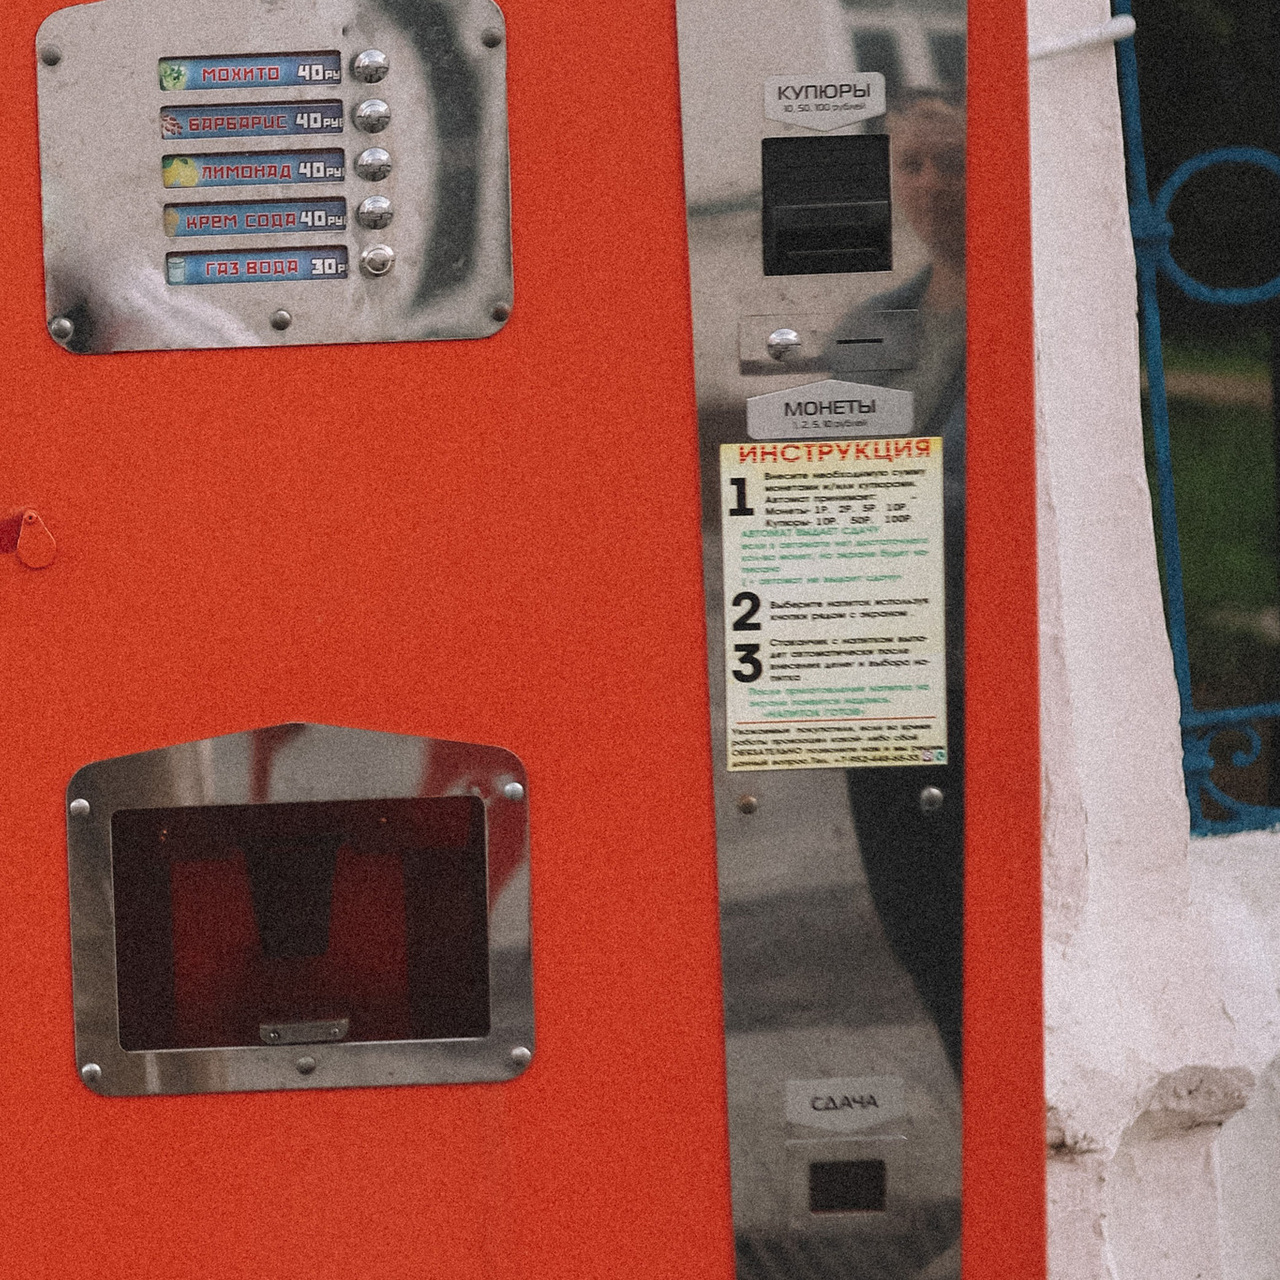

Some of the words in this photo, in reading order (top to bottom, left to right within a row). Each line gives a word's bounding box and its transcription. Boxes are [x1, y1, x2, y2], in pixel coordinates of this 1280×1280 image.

[202, 67, 280, 82] МОХИТО
[778, 83, 870, 100] КУПЮРЫ
[189, 115, 287, 131] БАРБАРИС
[202, 164, 292, 179] ЛИМОНАД
[187, 215, 237, 229] КРЕМ
[245, 213, 296, 228] СОДА
[785, 399, 876, 416] МОНЕТЫ
[739, 438, 931, 464] ИНСТРУКЦИЯ
[729, 478, 754, 516] 1
[732, 591, 761, 631] 2
[733, 643, 762, 683] 3
[810, 1094, 879, 1111] СДАЧА
